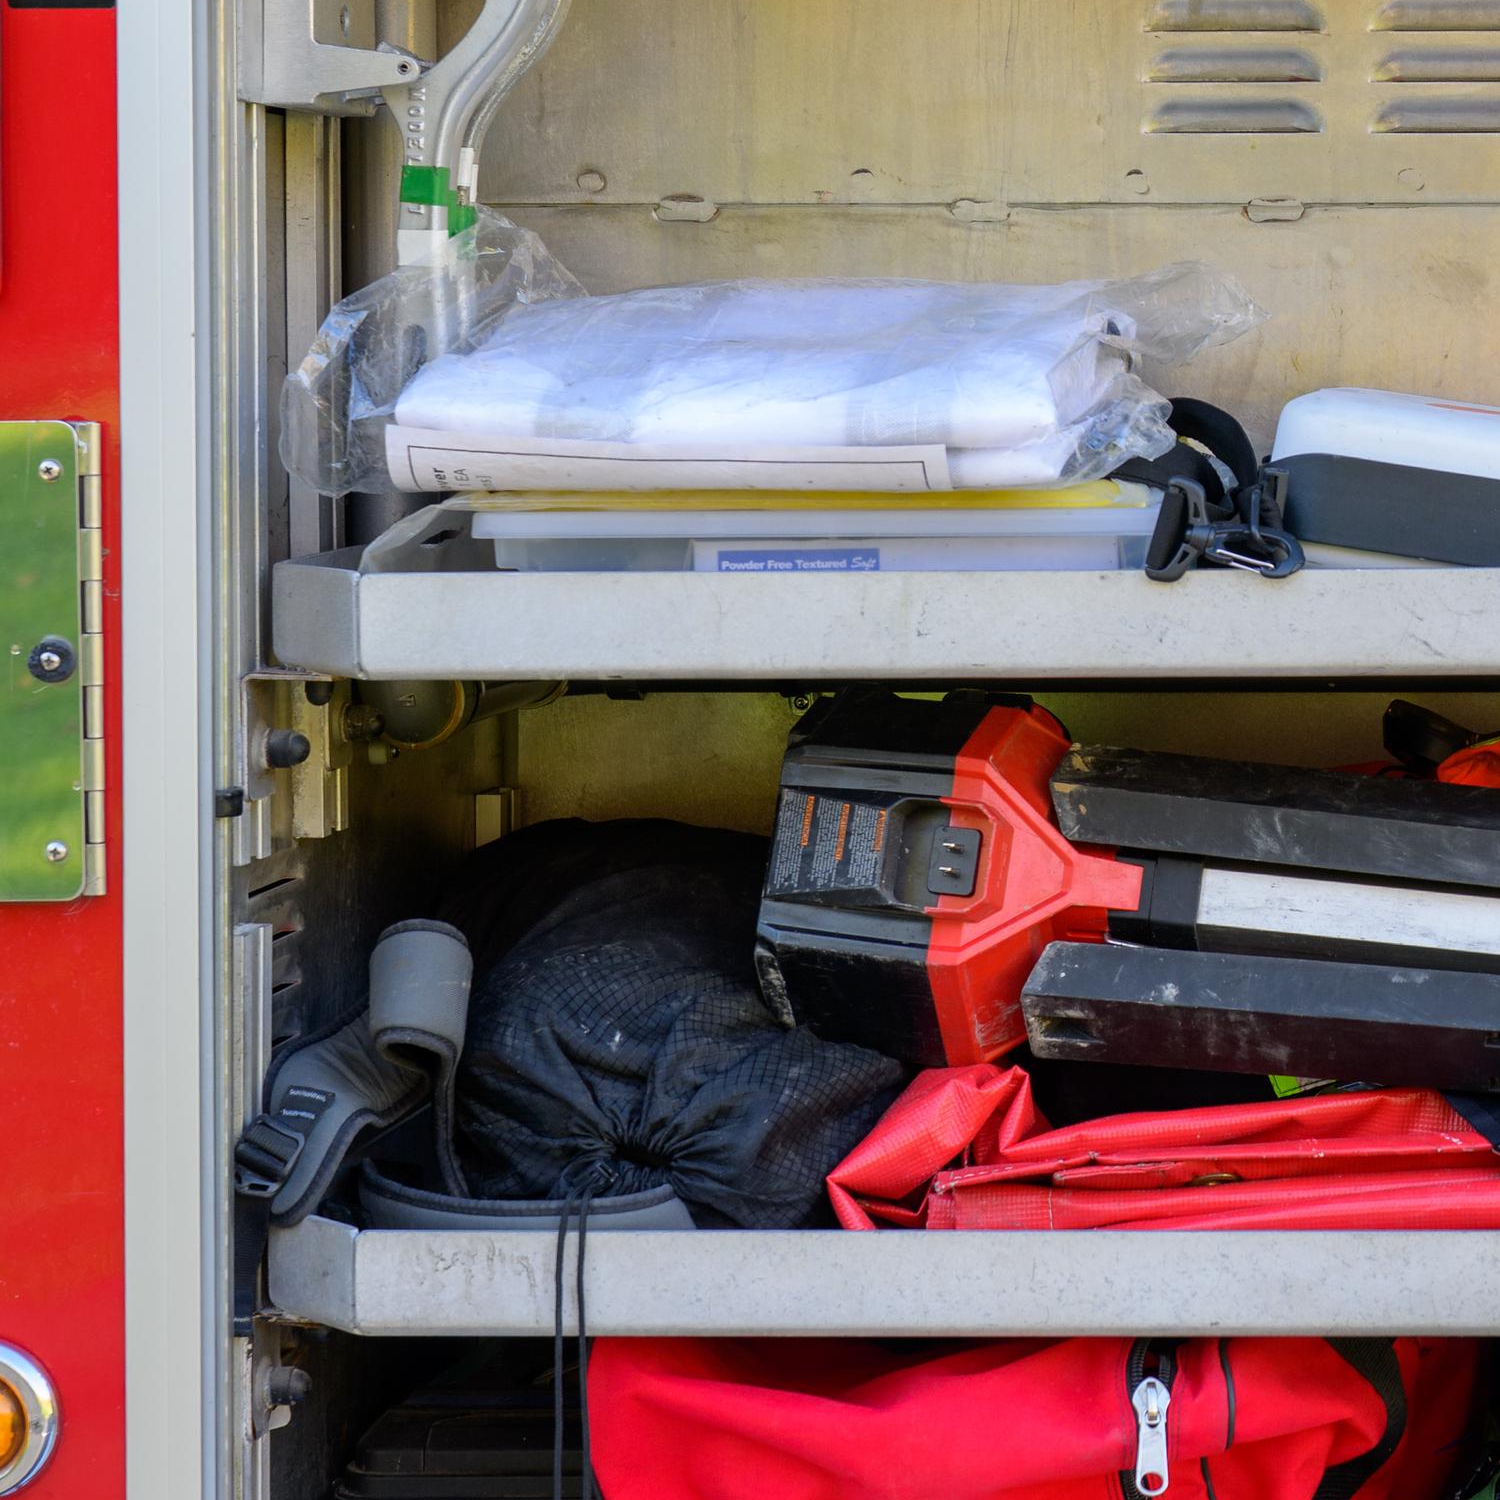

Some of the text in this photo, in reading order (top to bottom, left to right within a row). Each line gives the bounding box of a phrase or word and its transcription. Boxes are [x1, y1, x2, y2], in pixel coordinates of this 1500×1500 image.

[453, 468, 469, 481] EA
[722, 557, 877, 572] Powder Free Textured Soft
